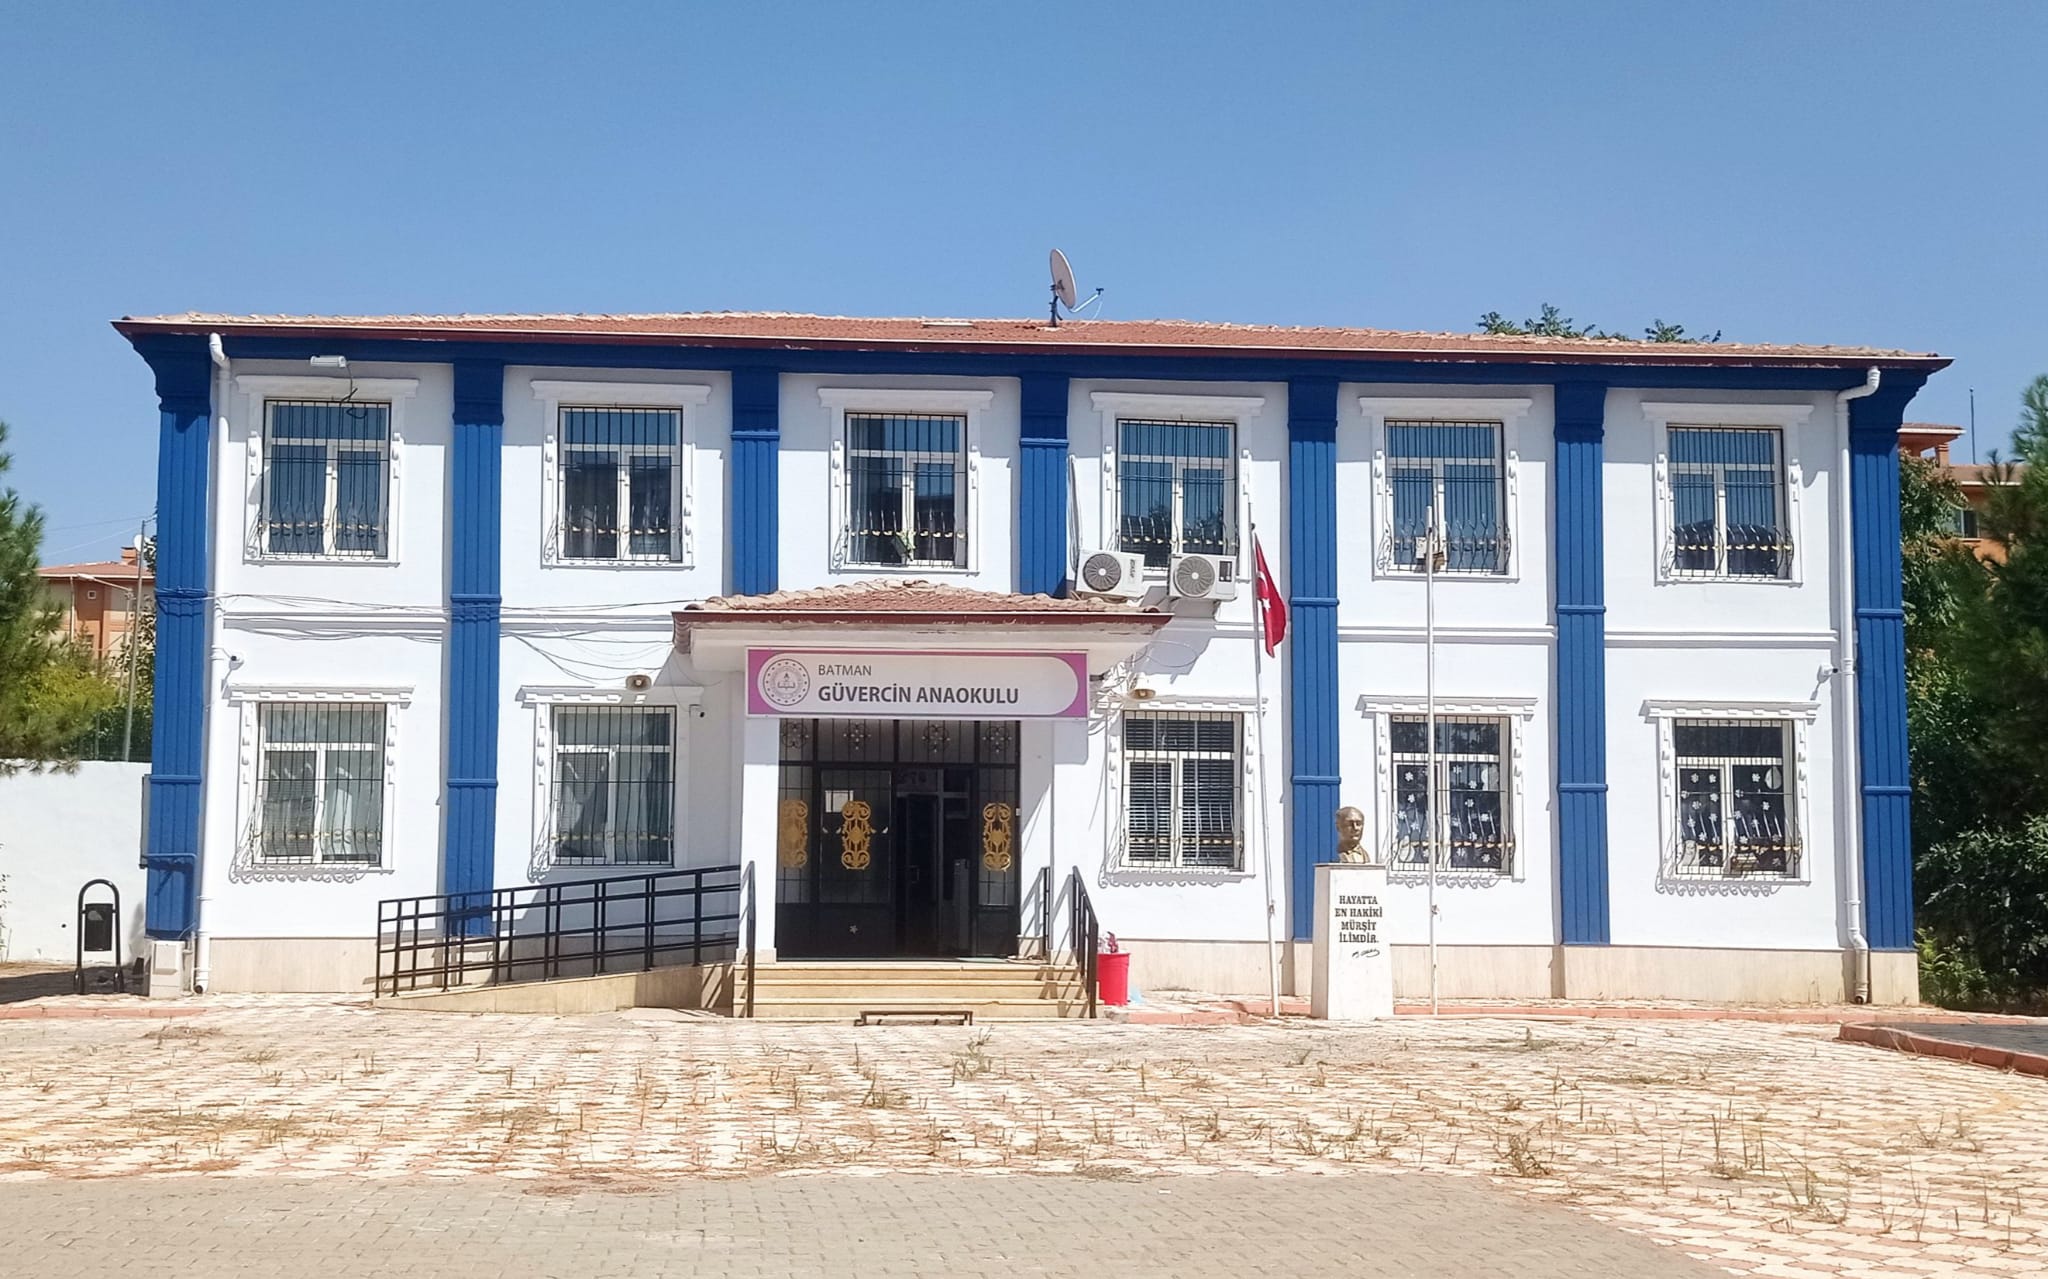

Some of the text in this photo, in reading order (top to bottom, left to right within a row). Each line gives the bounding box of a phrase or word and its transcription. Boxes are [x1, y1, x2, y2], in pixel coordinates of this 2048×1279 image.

[818, 664, 872, 676] BATMAN
[818, 682, 911, 703] GÜVERCİN
[916, 687, 1019, 704] ANAOKULU
[1339, 895, 1378, 905] HAYATTA
[1335, 906, 1383, 918] EN HAKİKİ
[1341, 919, 1377, 932] MÜRŞİT
[1339, 931, 1380, 943] İLİMDİR.
